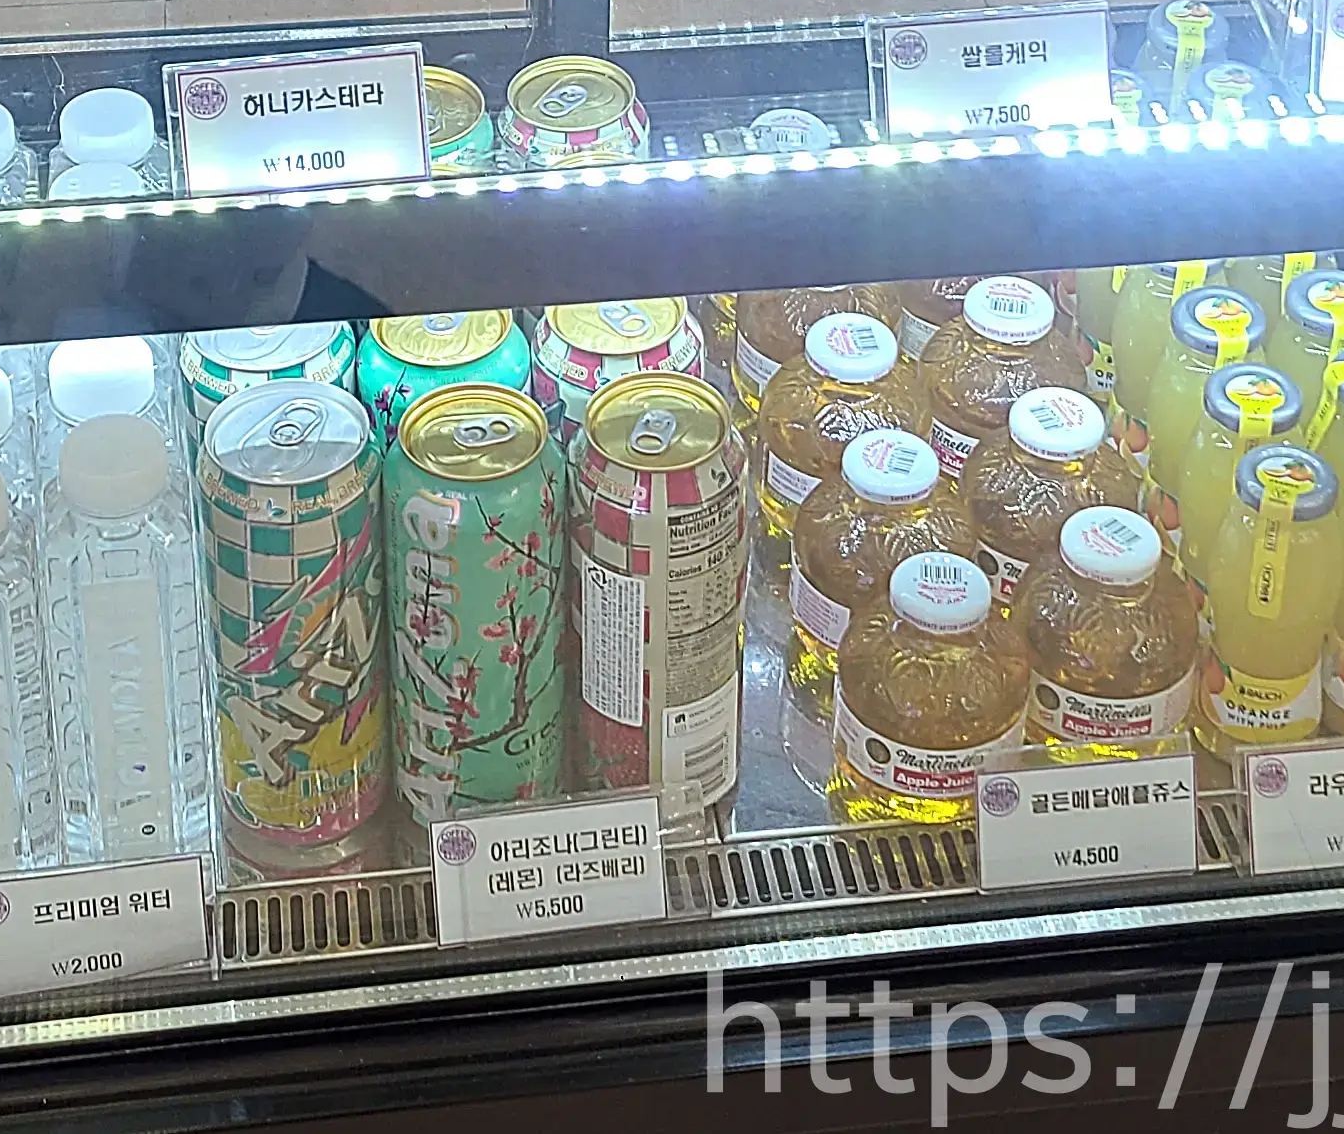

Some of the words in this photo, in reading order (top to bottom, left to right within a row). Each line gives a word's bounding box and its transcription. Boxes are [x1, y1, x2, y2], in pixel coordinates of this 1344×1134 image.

[961, 39, 1047, 68] 쌀롤케익
[243, 83, 384, 117] 허니카스테라
[965, 104, 1030, 125] ₩7,500
[263, 150, 345, 174] ₩14,000
[206, 472, 260, 511] BREWED
[291, 493, 334, 513] REAL
[669, 516, 716, 538] Nutrition
[669, 564, 702, 579] Calories
[1226, 700, 1291, 720] ORANGE
[1065, 720, 1106, 736] Apple
[1110, 724, 1149, 737] Juice
[897, 772, 938, 787] Apple
[1031, 779, 1191, 816] 골든메달애플쥬스
[489, 823, 649, 863] 아리조나(그린티)
[1055, 845, 1119, 868] ₩4,500
[488, 868, 544, 896] (레몬)
[556, 855, 646, 887] (라즈베리)
[33, 895, 121, 925] 프리미엄
[129, 888, 172, 913] 워터
[516, 894, 584, 919] ₩5,500
[52, 952, 123, 977] ₩2,000
